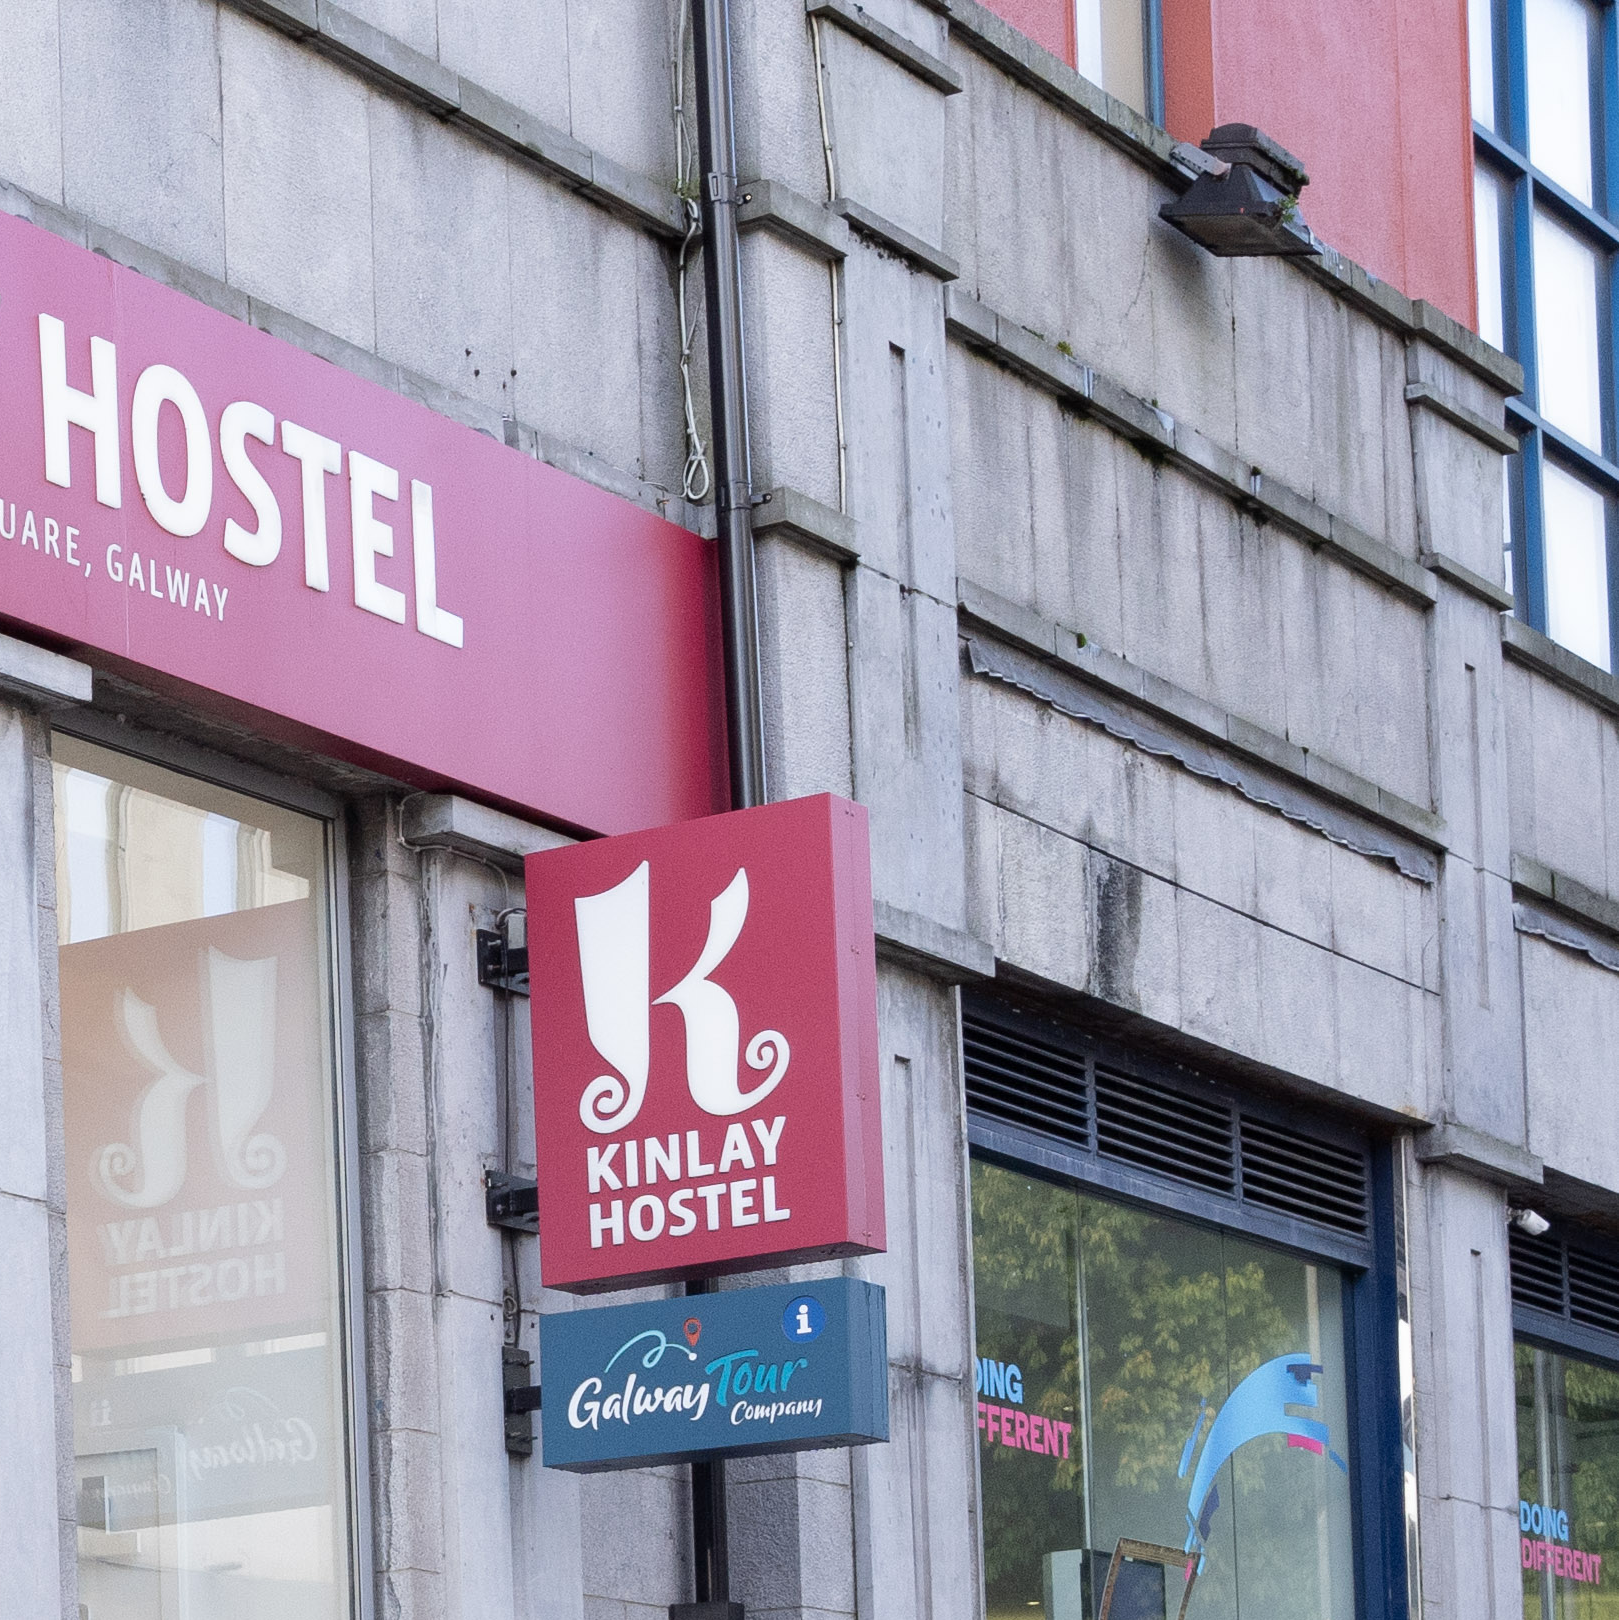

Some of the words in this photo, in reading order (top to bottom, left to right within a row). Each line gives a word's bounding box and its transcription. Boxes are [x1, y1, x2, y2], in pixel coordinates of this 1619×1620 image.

[38, 312, 465, 648] HOSTEL
[106, 541, 231, 622] GALWAY
[586, 1115, 787, 1194] KINLAY
[589, 1175, 791, 1249] HOSTEL
[567, 1373, 711, 1431] Galway
[704, 1349, 809, 1408] Tour
[729, 1397, 823, 1427] Company
[1519, 1499, 1569, 1542] DOING
[1521, 1537, 1602, 1585] DIFFERENT
